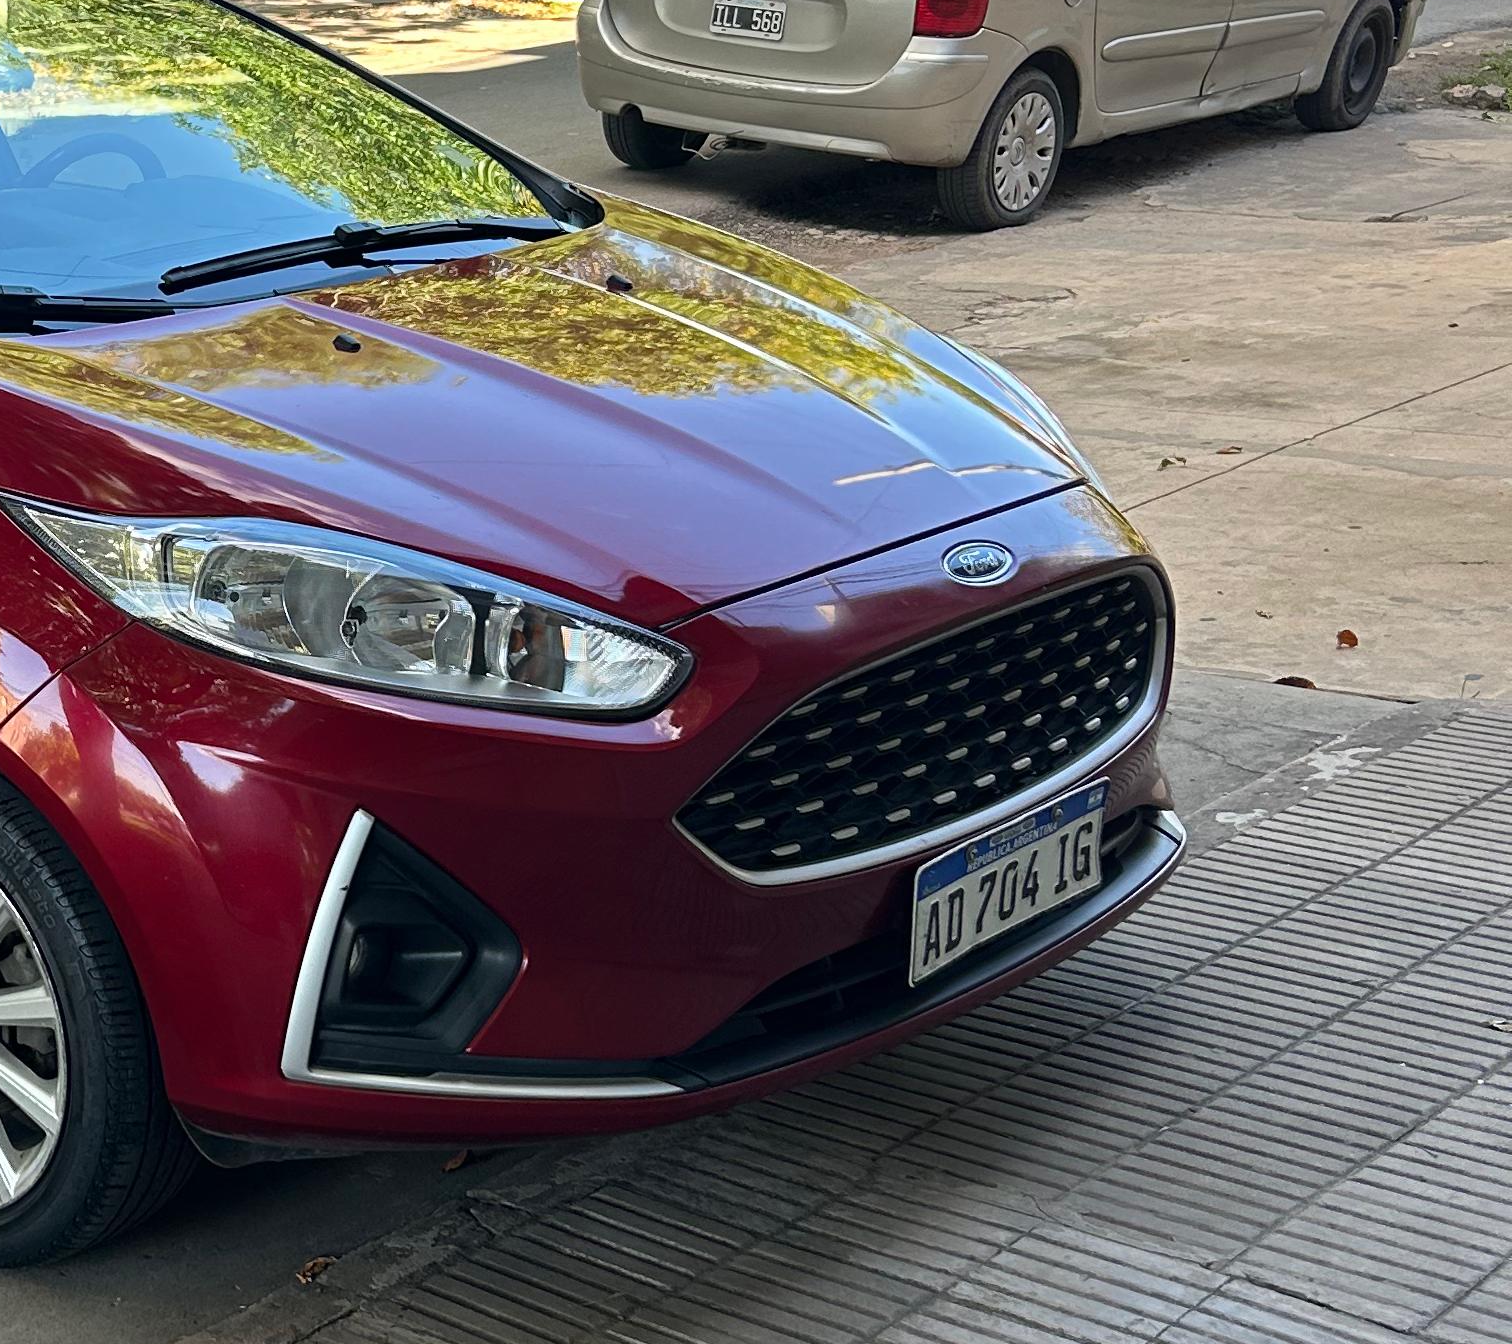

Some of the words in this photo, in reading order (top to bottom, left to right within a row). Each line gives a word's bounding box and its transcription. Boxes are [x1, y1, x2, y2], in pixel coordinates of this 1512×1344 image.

[713, 4, 742, 28] ILL
[751, 9, 782, 33] 568
[958, 550, 1001, 575] Ford
[922, 887, 966, 966] AD
[975, 849, 1040, 934] 704
[1054, 820, 1094, 894] IG
